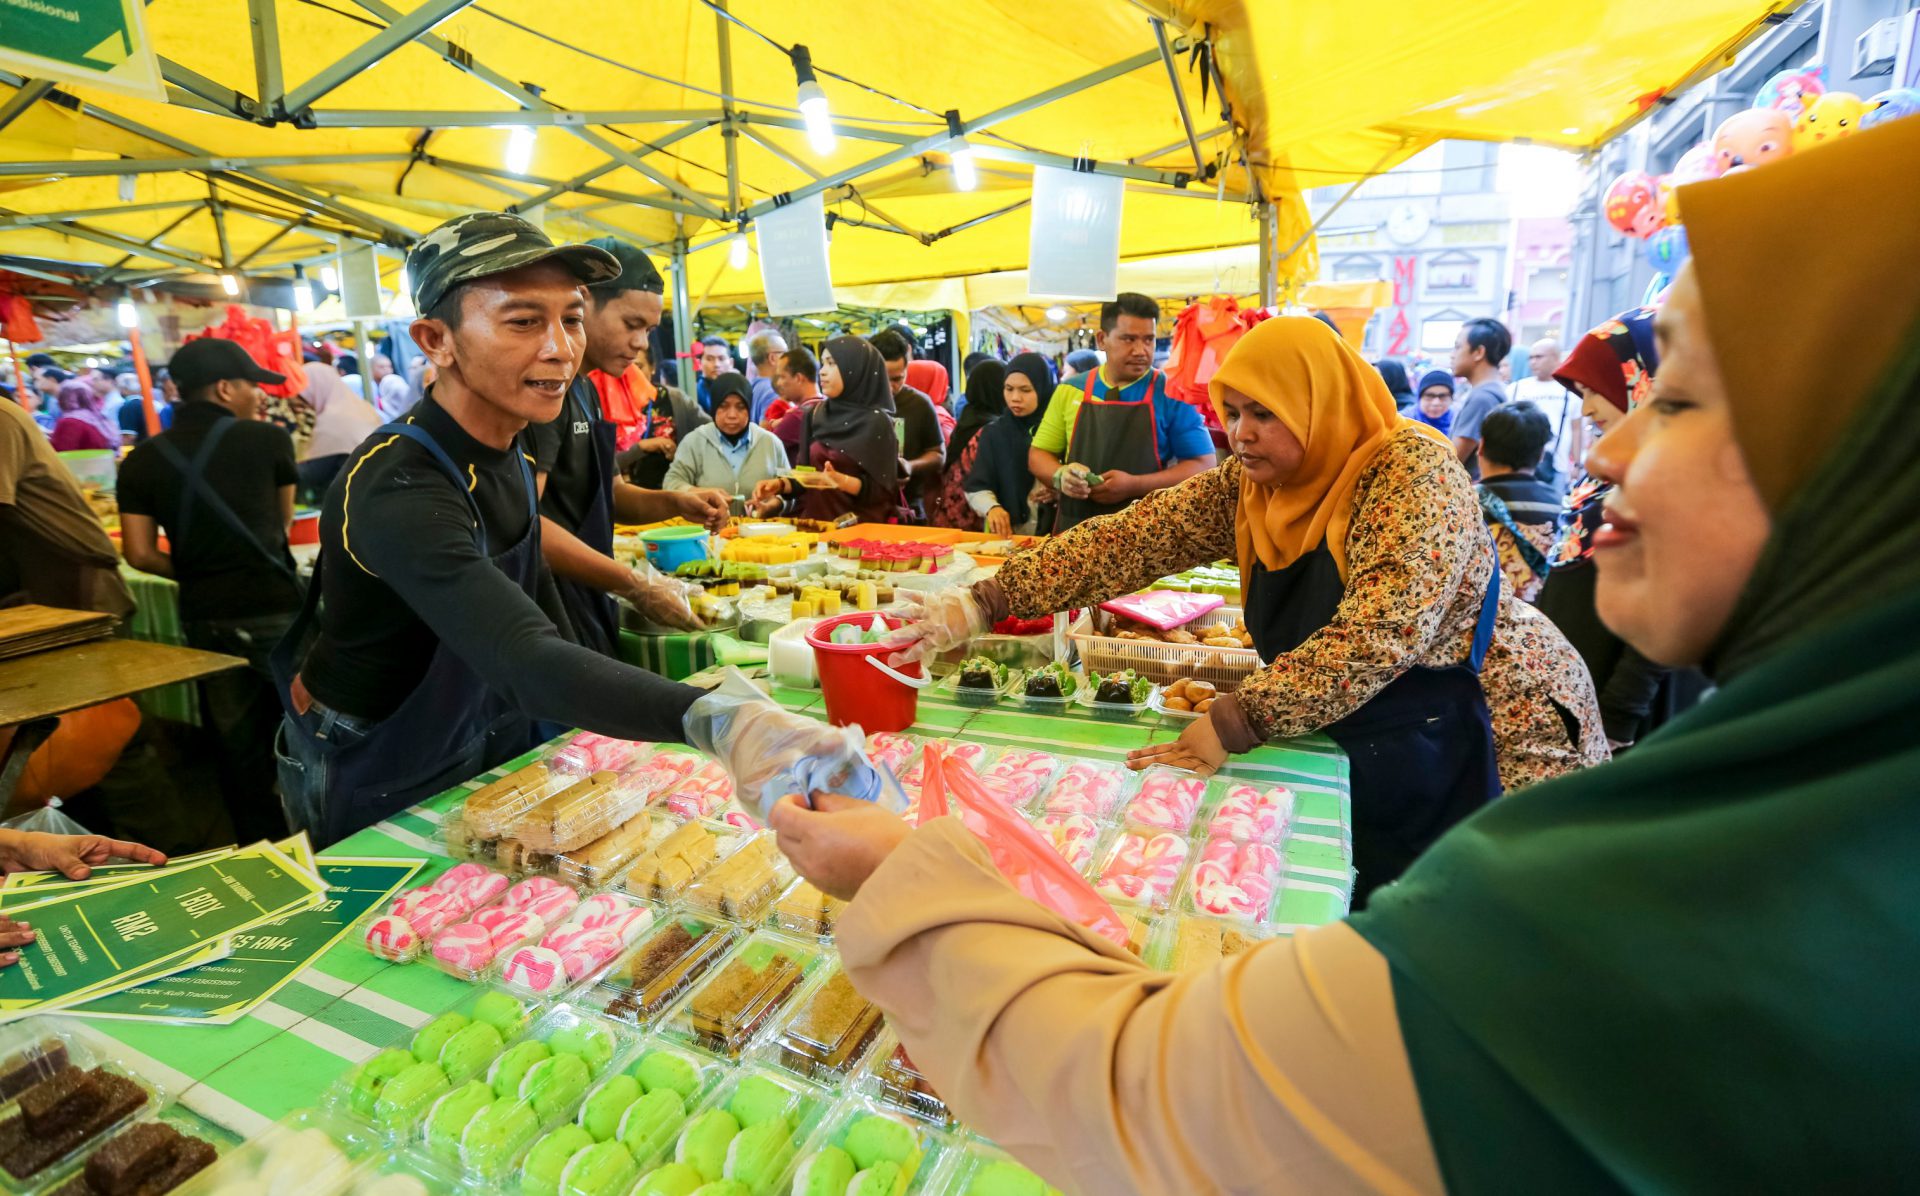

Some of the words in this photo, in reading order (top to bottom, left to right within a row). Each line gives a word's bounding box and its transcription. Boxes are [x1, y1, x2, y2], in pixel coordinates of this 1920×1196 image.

[1386, 256, 1417, 356] MUAZ
[174, 887, 206, 900] 1
[180, 892, 225, 919] BOX
[308, 900, 343, 912] M3
[111, 910, 159, 942] RM2
[248, 936, 299, 951] RM4
[197, 965, 245, 974] TEMPAHAN
[186, 991, 233, 999] Tradisional
